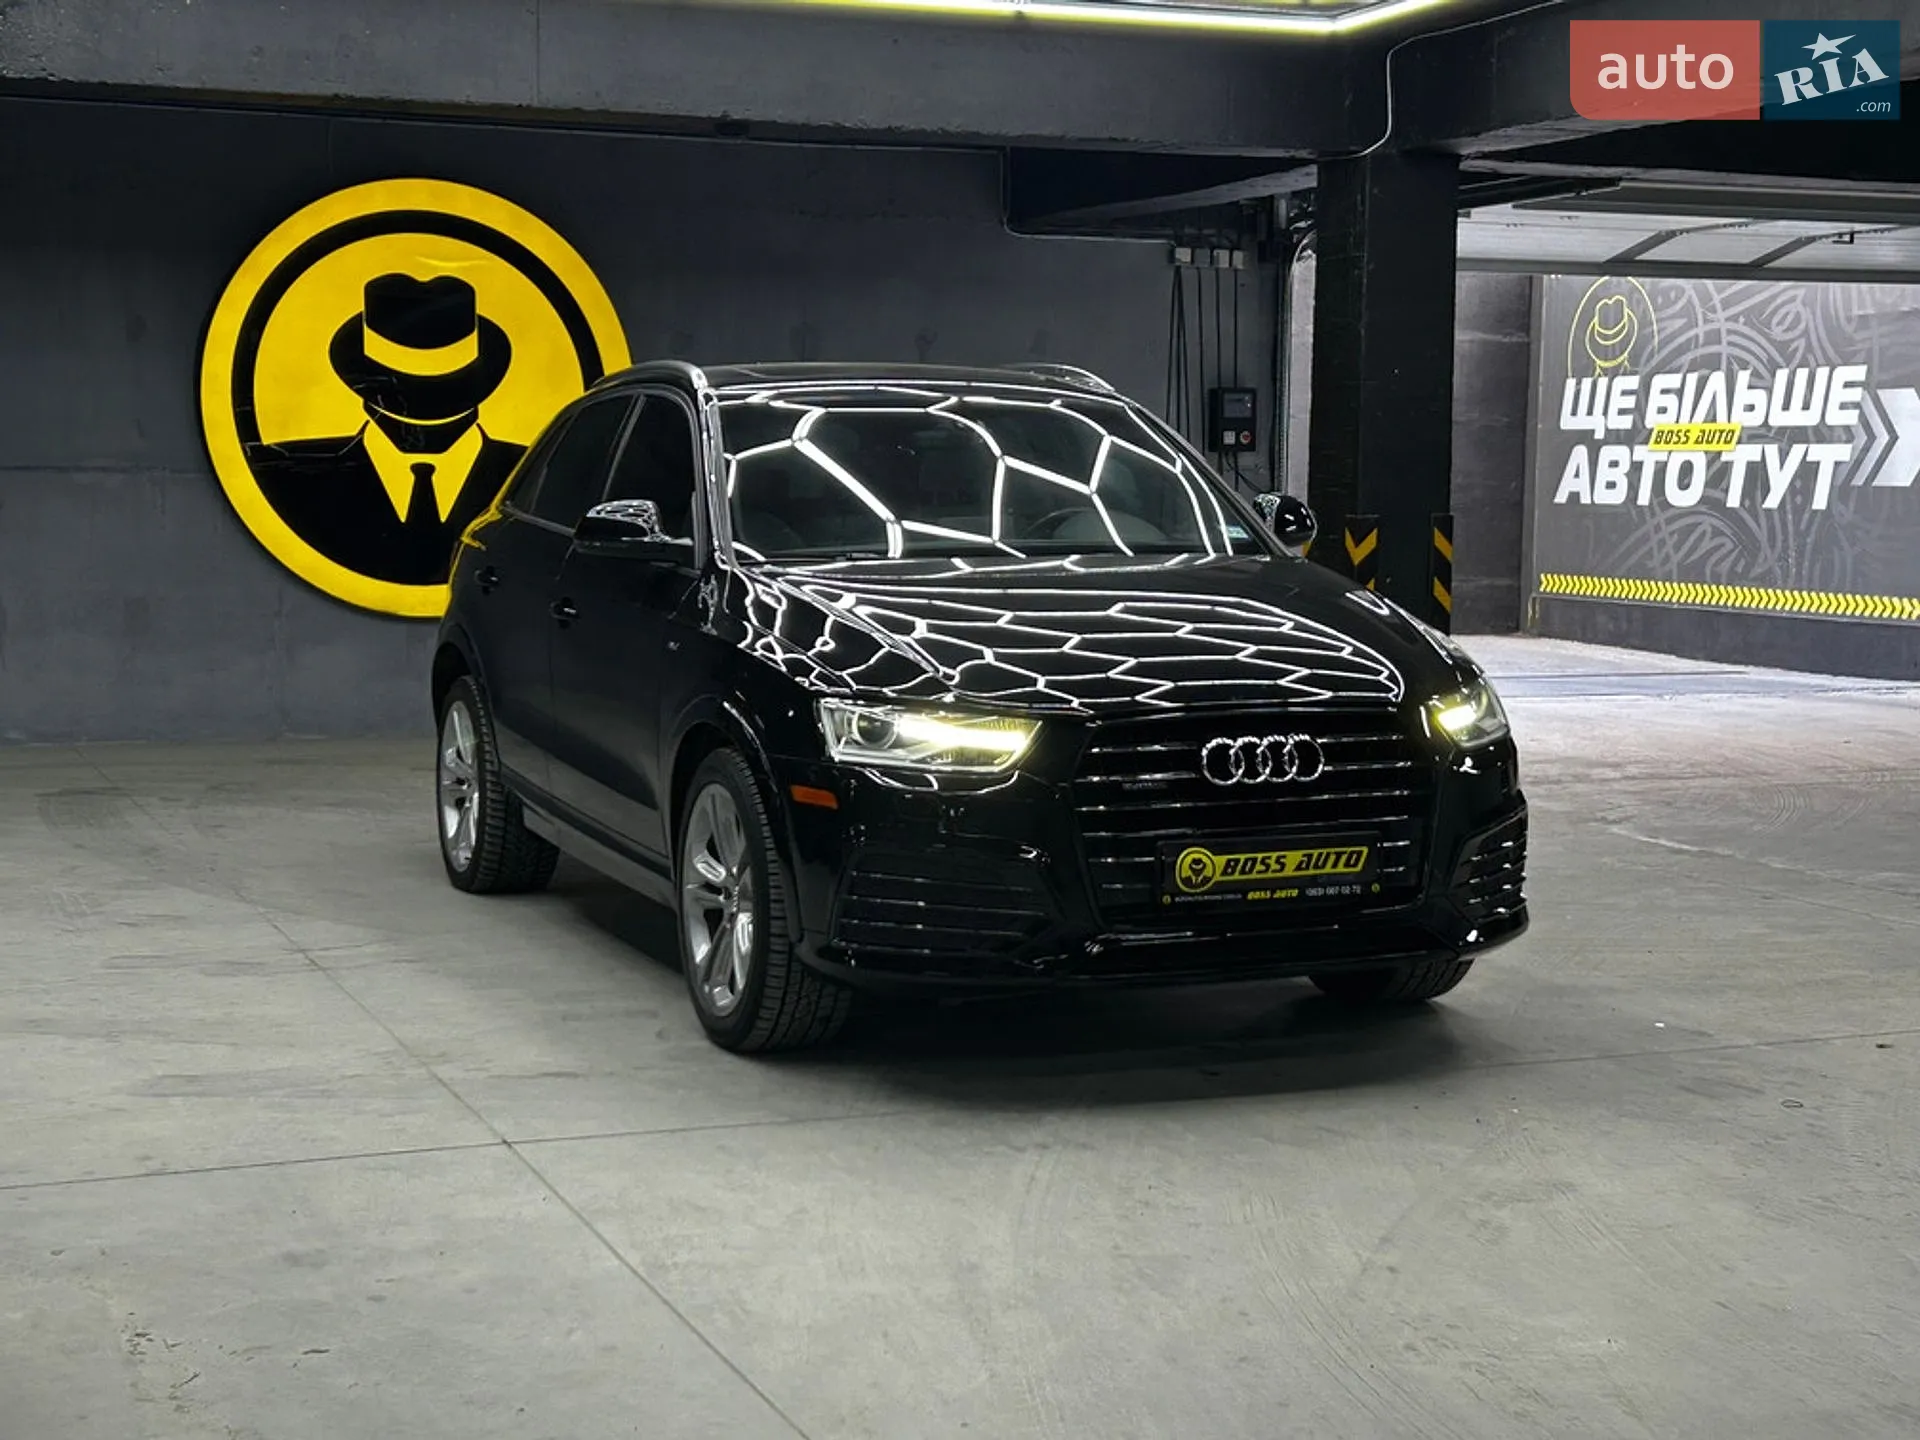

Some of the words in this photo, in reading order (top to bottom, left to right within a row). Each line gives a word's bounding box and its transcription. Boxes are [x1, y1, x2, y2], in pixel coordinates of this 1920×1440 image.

[1560, 375, 1640, 439] ЩЕ
[1645, 365, 1867, 428] БІЛЬШЕ
[1653, 428, 1691, 446] BOSS
[1694, 428, 1737, 445] AUTO
[1553, 444, 1706, 508] АВТО
[1719, 443, 1852, 510] ТУТ
[1219, 855, 1288, 877] BOSS
[1292, 850, 1364, 872] AUTO
